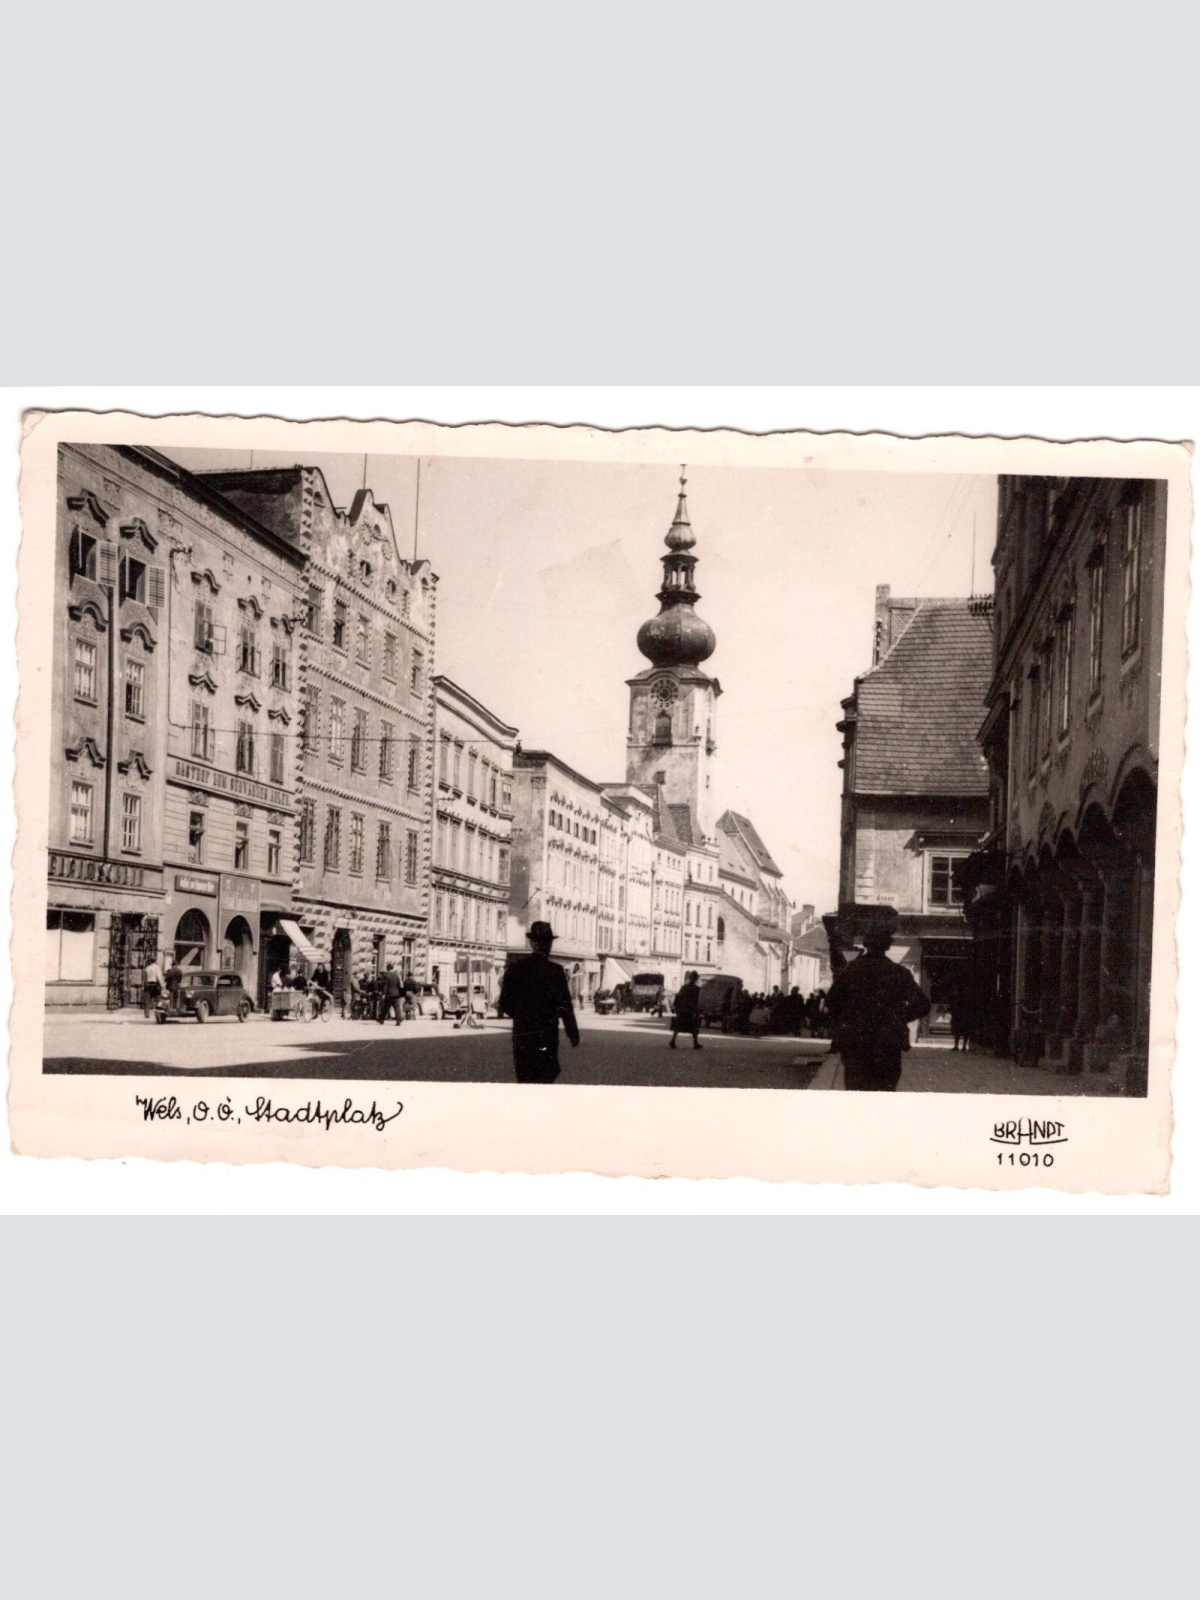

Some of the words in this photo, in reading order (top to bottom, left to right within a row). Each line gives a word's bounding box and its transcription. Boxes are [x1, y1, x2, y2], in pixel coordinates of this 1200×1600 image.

[246, 1096, 404, 1132] Stadtplatz
[994, 1117, 1065, 1140] BRANDT
[997, 1152, 1054, 1168] 11010
